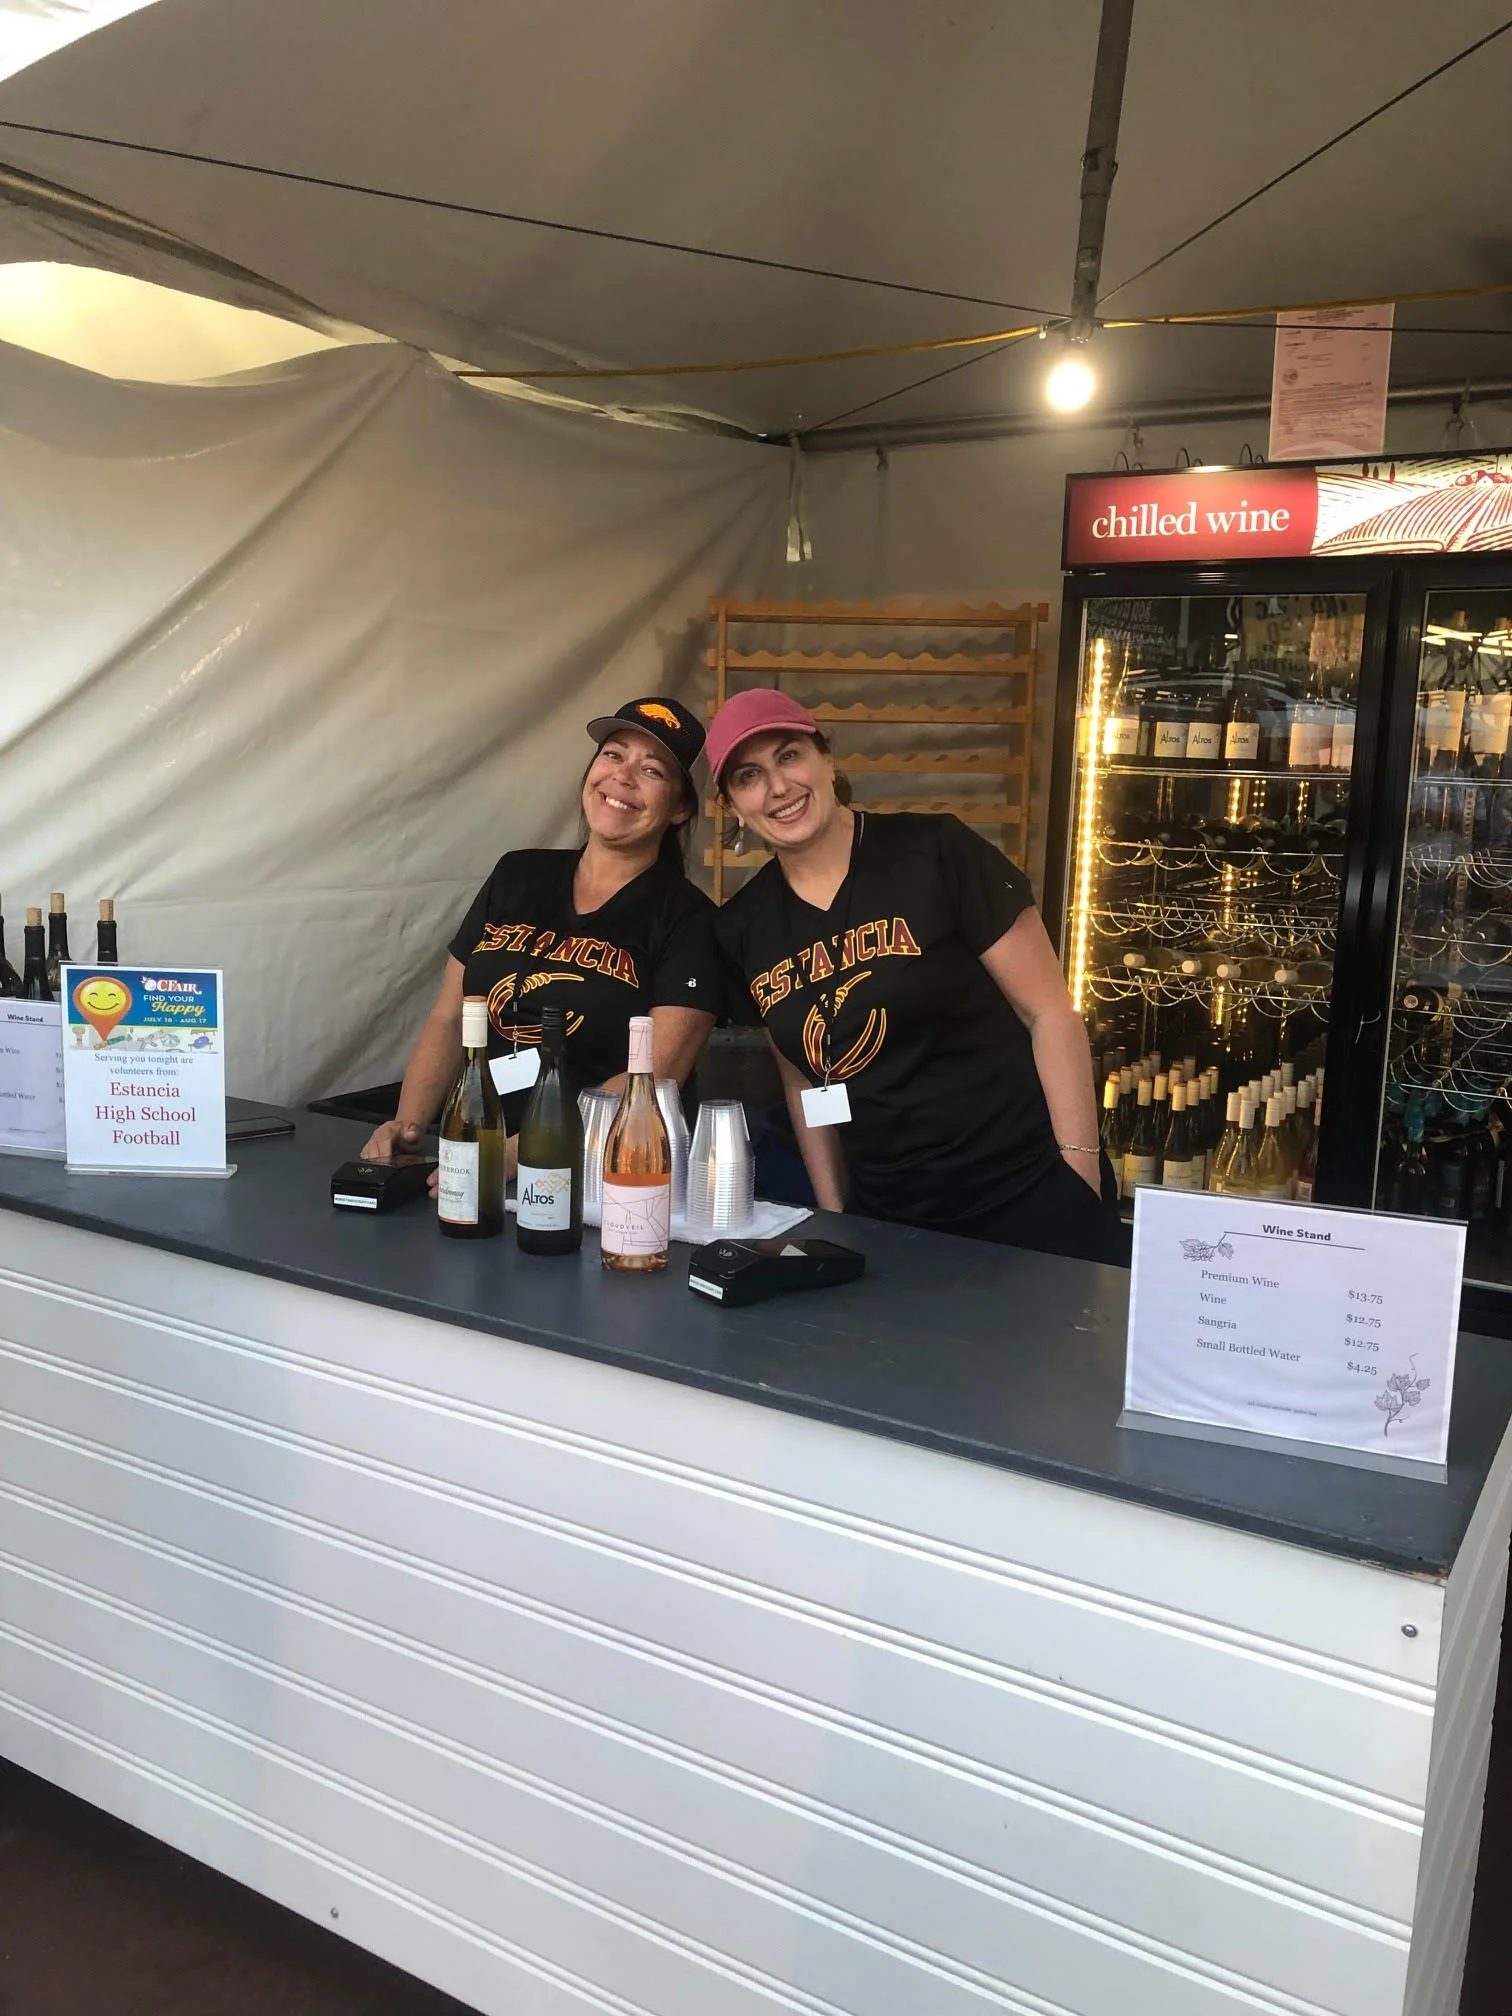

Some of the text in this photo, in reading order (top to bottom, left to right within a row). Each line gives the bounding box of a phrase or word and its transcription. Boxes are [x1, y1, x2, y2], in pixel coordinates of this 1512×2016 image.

[1092, 500, 1290, 539] chilled wine
[143, 994, 195, 1003] FIND YOUR
[151, 1001, 206, 1017] Happy
[7, 1013, 44, 1023] Wine Stand
[94, 1053, 127, 1065] Serving
[130, 1056, 146, 1065] you
[148, 1055, 179, 1066] tonight
[110, 1066, 154, 1075] volunteers
[110, 1082, 180, 1097] Estancia
[95, 1105, 197, 1123] High School
[112, 1130, 180, 1146] Football
[1262, 1224, 1331, 1241] Wine Stand
[1201, 1269, 1280, 1289] Premium Wine
[1200, 1292, 1227, 1305] Wine
[1348, 1289, 1383, 1305] $13.75
[1197, 1315, 1237, 1330] Sangria
[1346, 1313, 1382, 1328] $12.75
[1196, 1338, 1302, 1362] Small Bottled Water
[1344, 1336, 1380, 1352] $12.75
[1346, 1361, 1378, 1376] $4.25
